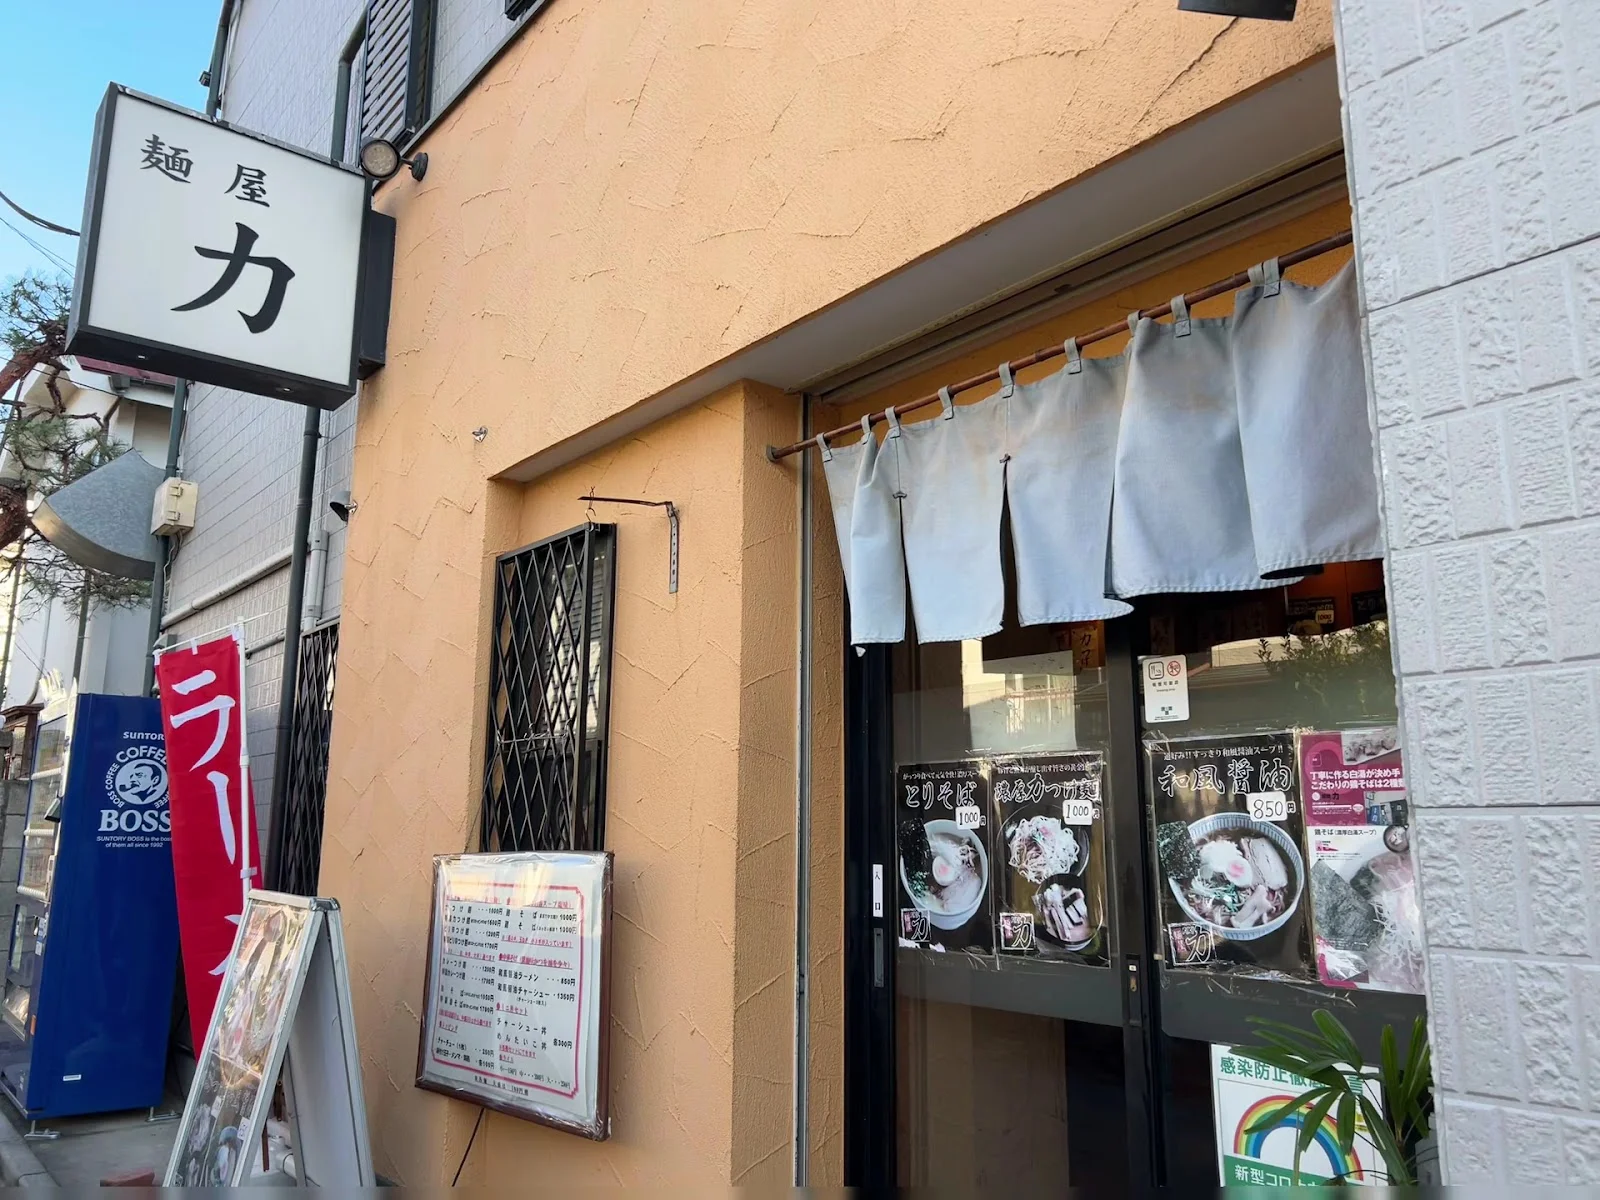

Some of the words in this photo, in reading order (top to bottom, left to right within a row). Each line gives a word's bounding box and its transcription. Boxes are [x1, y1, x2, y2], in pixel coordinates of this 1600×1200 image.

[170, 222, 295, 333] 力
[97, 809, 172, 833] BOSS
[1253, 799, 1284, 819] 850
